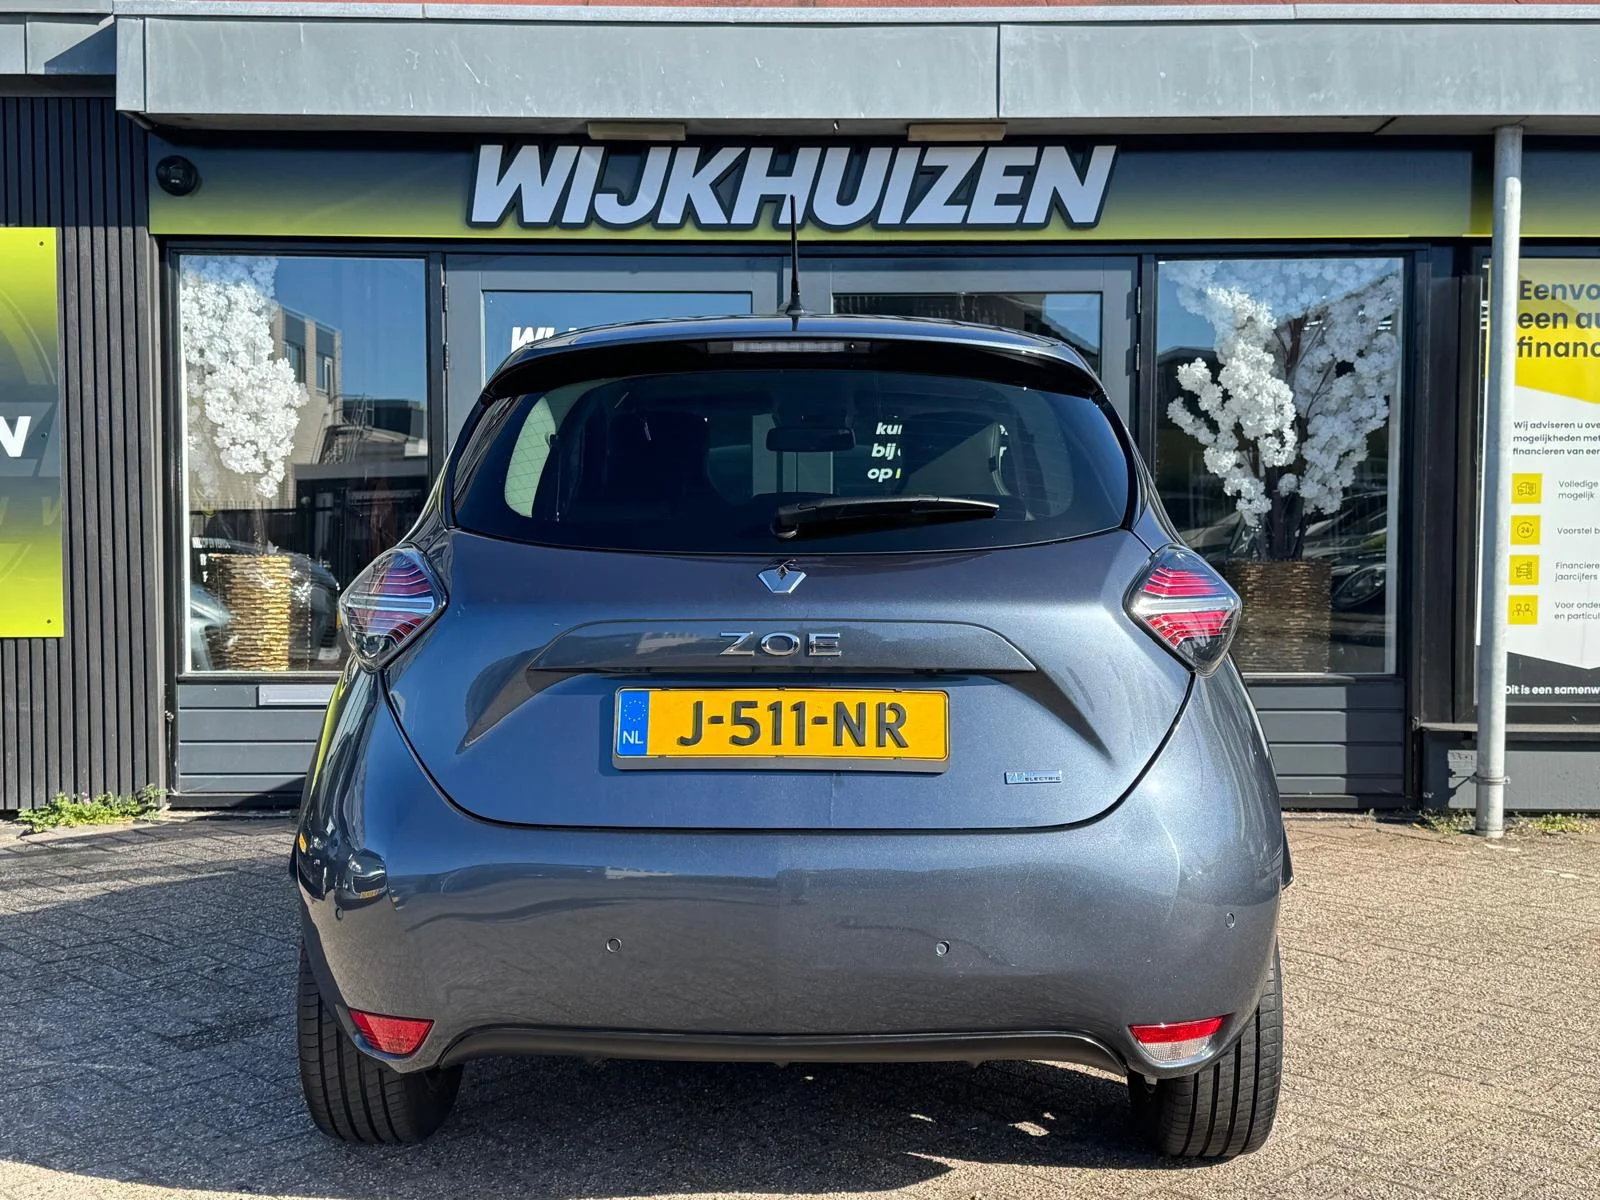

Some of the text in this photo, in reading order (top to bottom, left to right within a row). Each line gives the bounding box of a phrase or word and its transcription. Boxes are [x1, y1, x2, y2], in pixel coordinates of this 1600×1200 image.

[469, 144, 1118, 226] WIJKHUIZEN
[1519, 280, 1600, 301] Eenvo
[1517, 312, 1568, 329] een
[1513, 421, 1528, 431] Wij
[1530, 421, 1575, 429] adviseren
[1513, 434, 1581, 444] mogelijkheden
[871, 443, 896, 460] bij
[1513, 447, 1565, 455] financieren
[867, 468, 893, 482] op
[1558, 480, 1598, 489] Volledige
[1558, 491, 1594, 501] mogelijk
[1557, 527, 1592, 535] Voorstel
[1555, 572, 1597, 582] jaarcijfers
[1555, 601, 1574, 609] Voor
[719, 631, 841, 657] ZOE
[1504, 684, 1520, 695] Dit
[1521, 684, 1530, 695] is
[1532, 686, 1552, 695] een
[622, 700, 910, 749] NL J-511-NR
